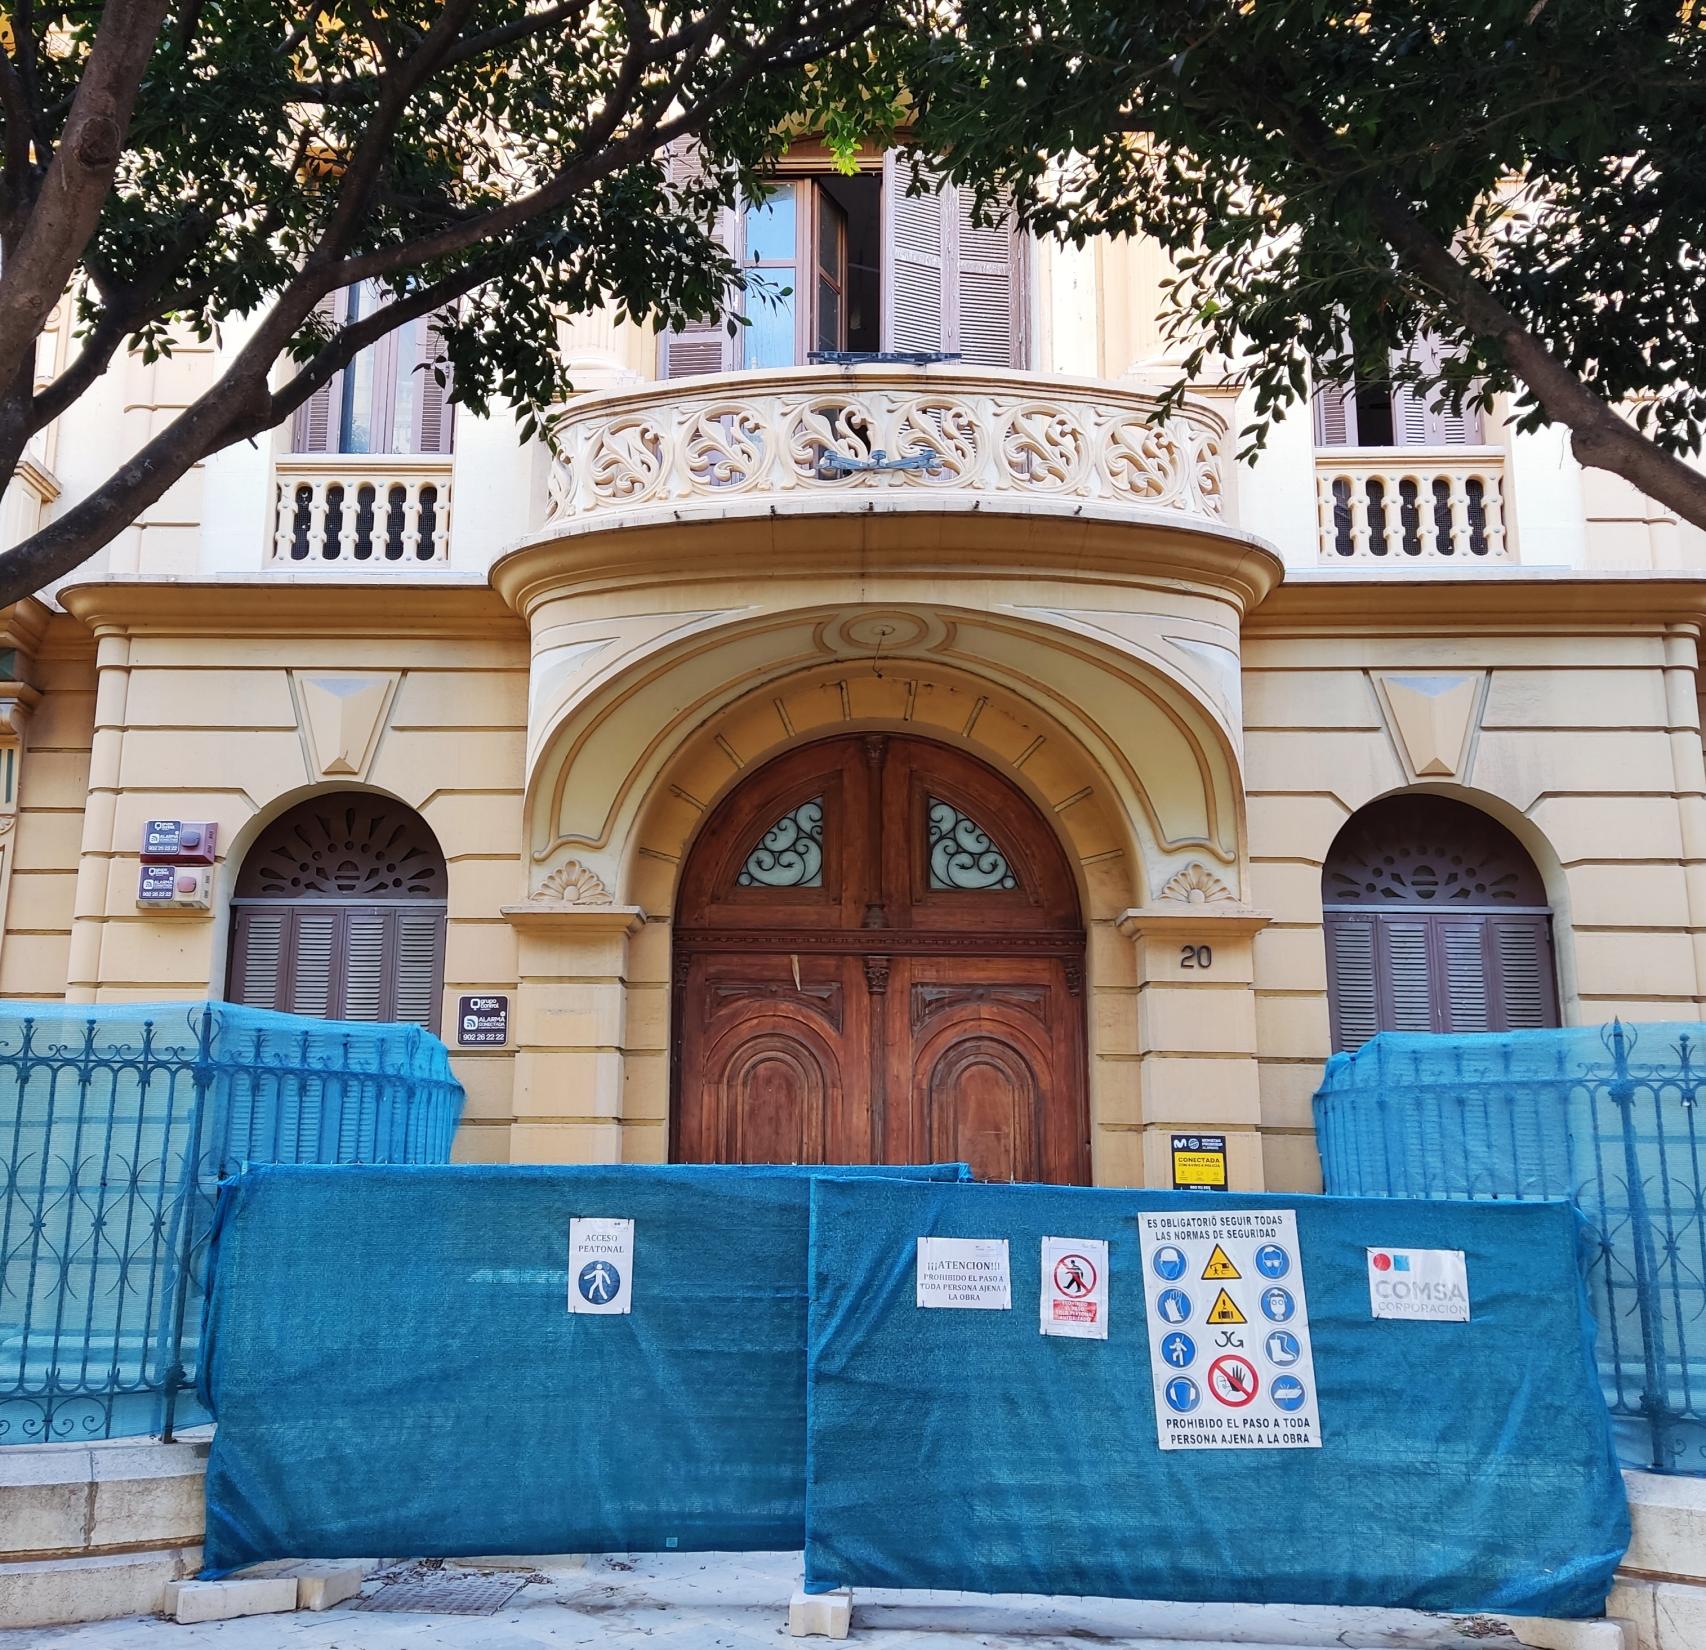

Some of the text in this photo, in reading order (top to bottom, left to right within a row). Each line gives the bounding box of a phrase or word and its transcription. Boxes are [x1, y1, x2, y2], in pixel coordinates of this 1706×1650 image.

[1181, 945, 1212, 968] 20
[1148, 1219, 1158, 1228] ES
[1220, 1216, 1252, 1226] SEGUIR
[1255, 1215, 1283, 1225] TODAS
[585, 1234, 618, 1242] ACCESO
[1156, 1228, 1276, 1241] LAS NORMAS DE SEGURIDAD
[578, 1245, 624, 1253] PEATONAL
[924, 1273, 966, 1281] PROHIBIDO
[1376, 1280, 1466, 1302] COMSA
[1378, 1301, 1467, 1315] CORPORACIÓN
[1166, 1418, 1310, 1428] PROHIBIDO EL PASO A TODA
[1171, 1434, 1309, 1444] PERSONA AJENA A LA OBRA
